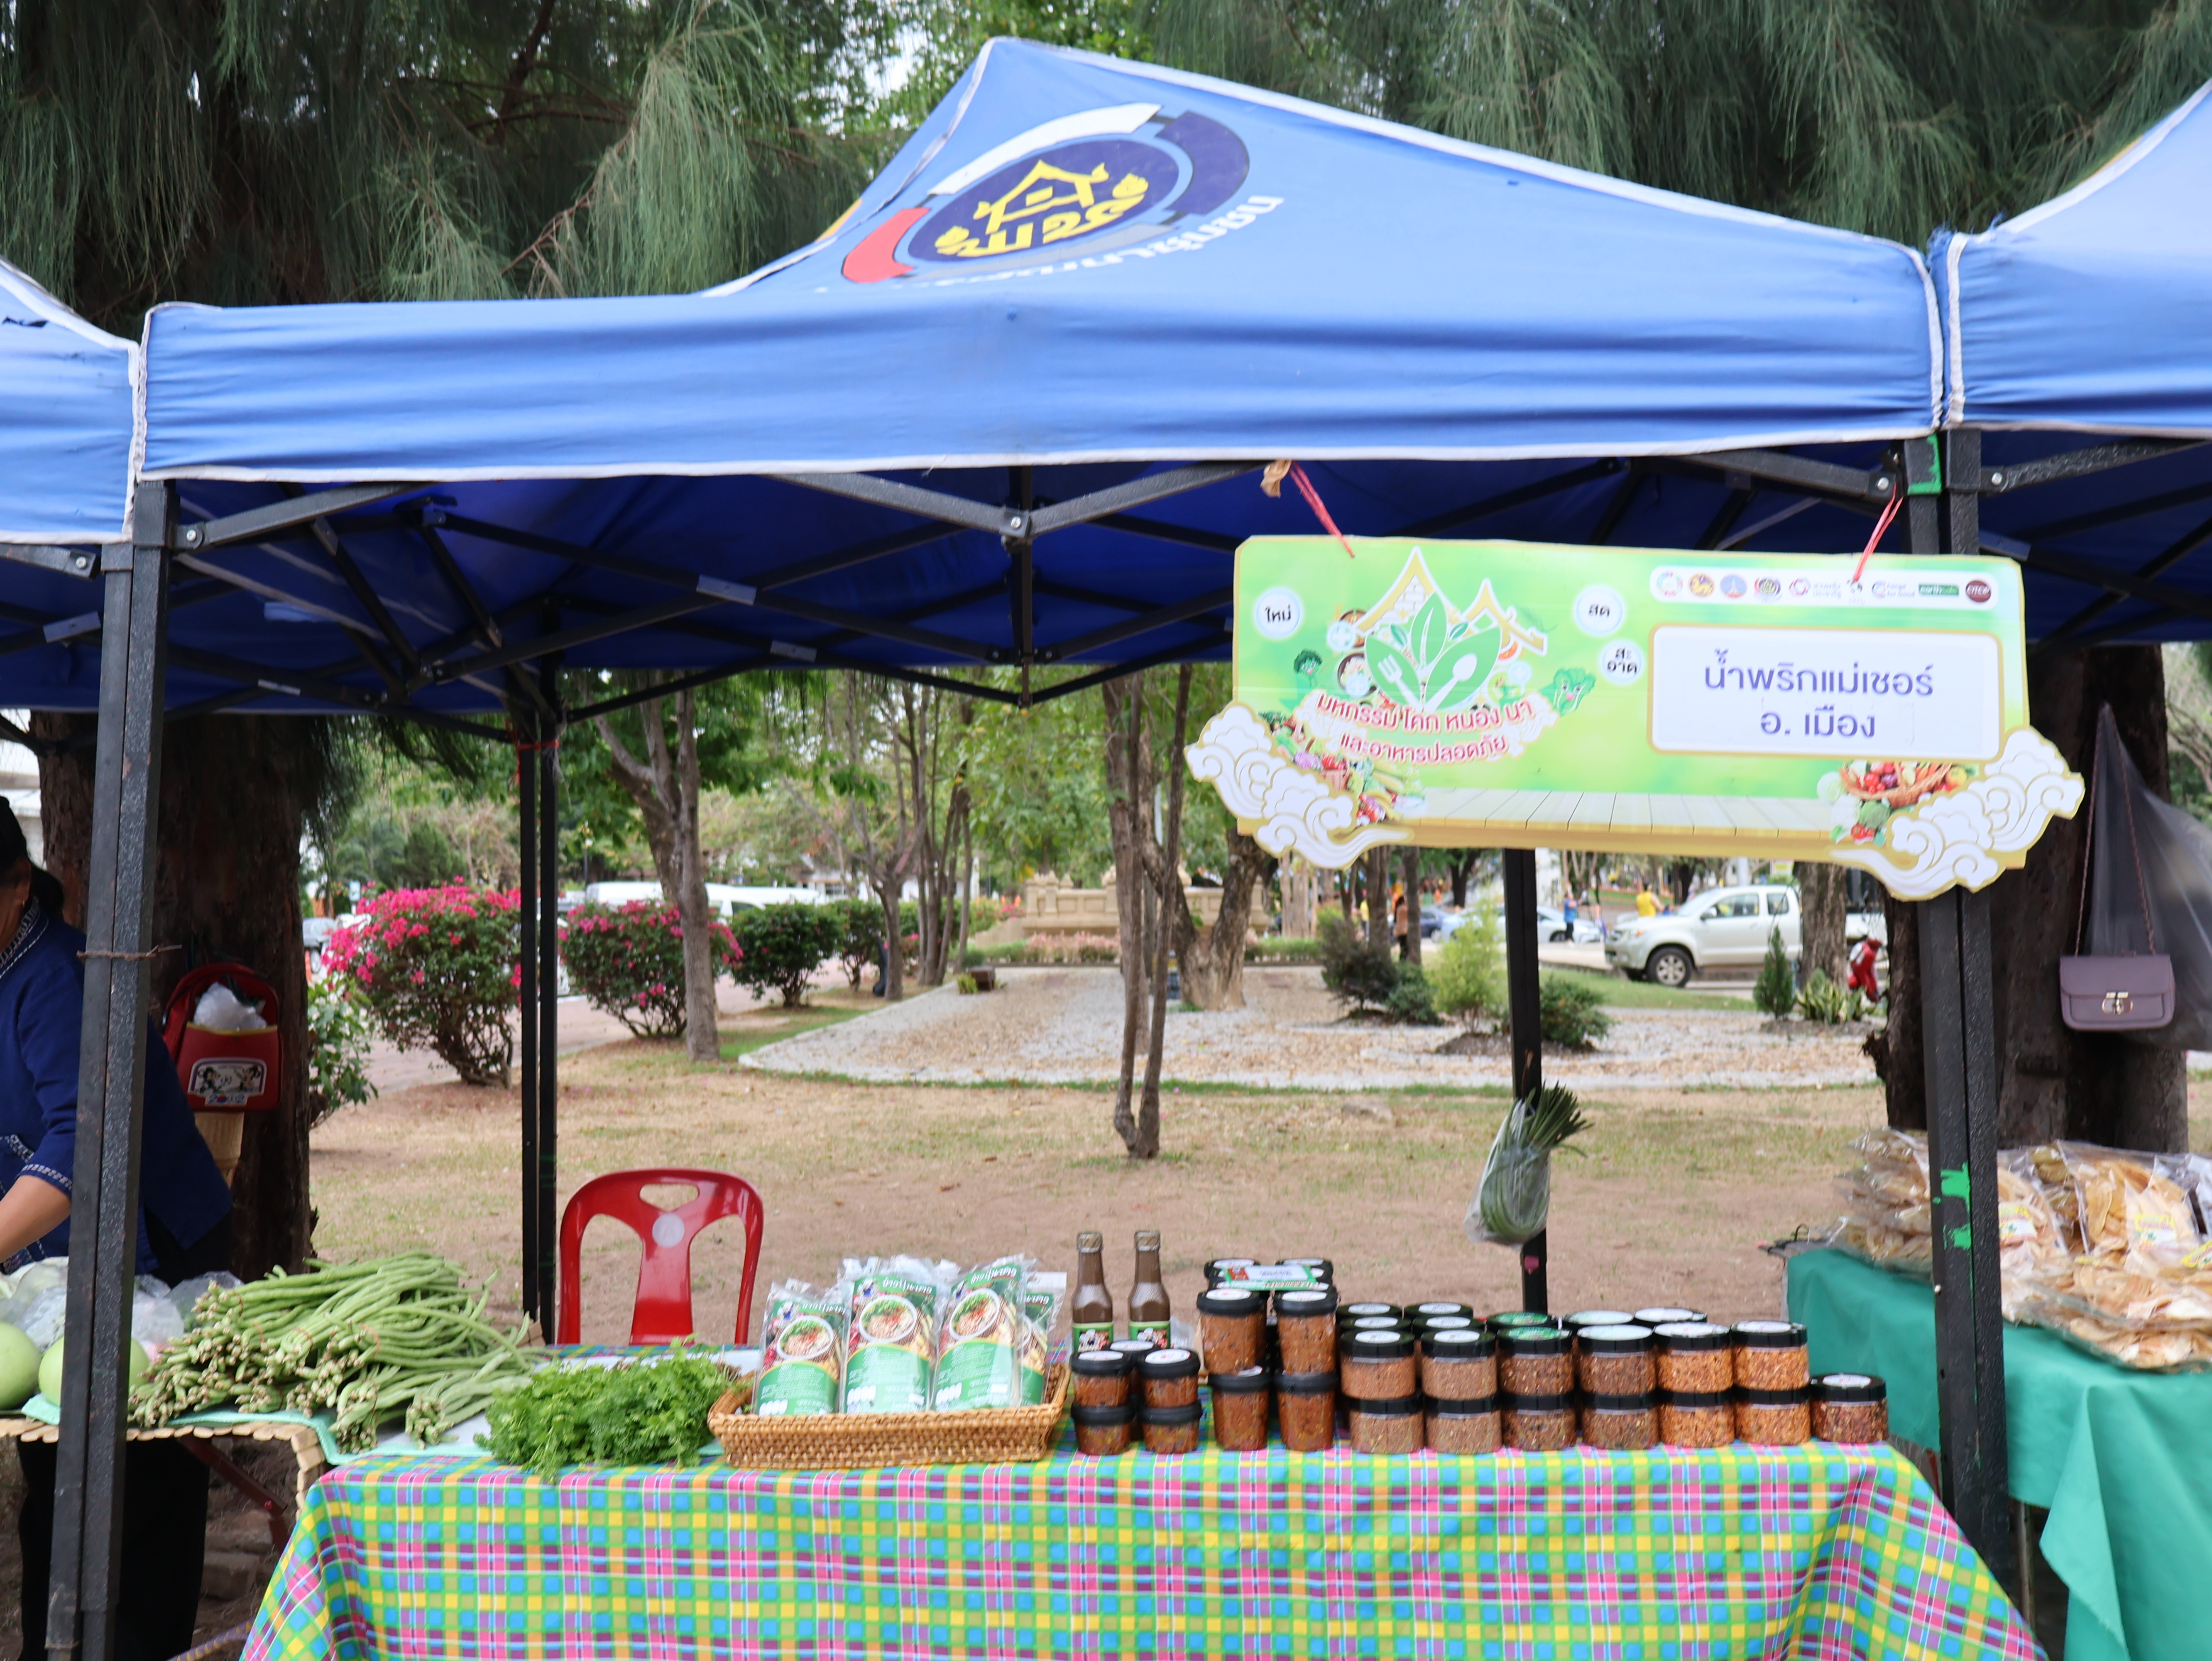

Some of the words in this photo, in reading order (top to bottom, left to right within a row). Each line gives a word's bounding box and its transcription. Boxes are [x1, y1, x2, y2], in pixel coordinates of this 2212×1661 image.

[1264, 604, 1291, 622] ใหม่
[1588, 604, 1610, 617] สด
[1704, 648, 1934, 696] น้ำพริกแม่เชอร์
[1317, 693, 1398, 729] มหกรรม
[1403, 706, 1440, 732] โคก
[1446, 710, 1500, 730] หนอง
[1505, 701, 1534, 723] นา
[1760, 711, 1791, 735] อ.
[1804, 703, 1875, 738] เมือง
[1339, 733, 1509, 764] และอาหารปลอดภัย
